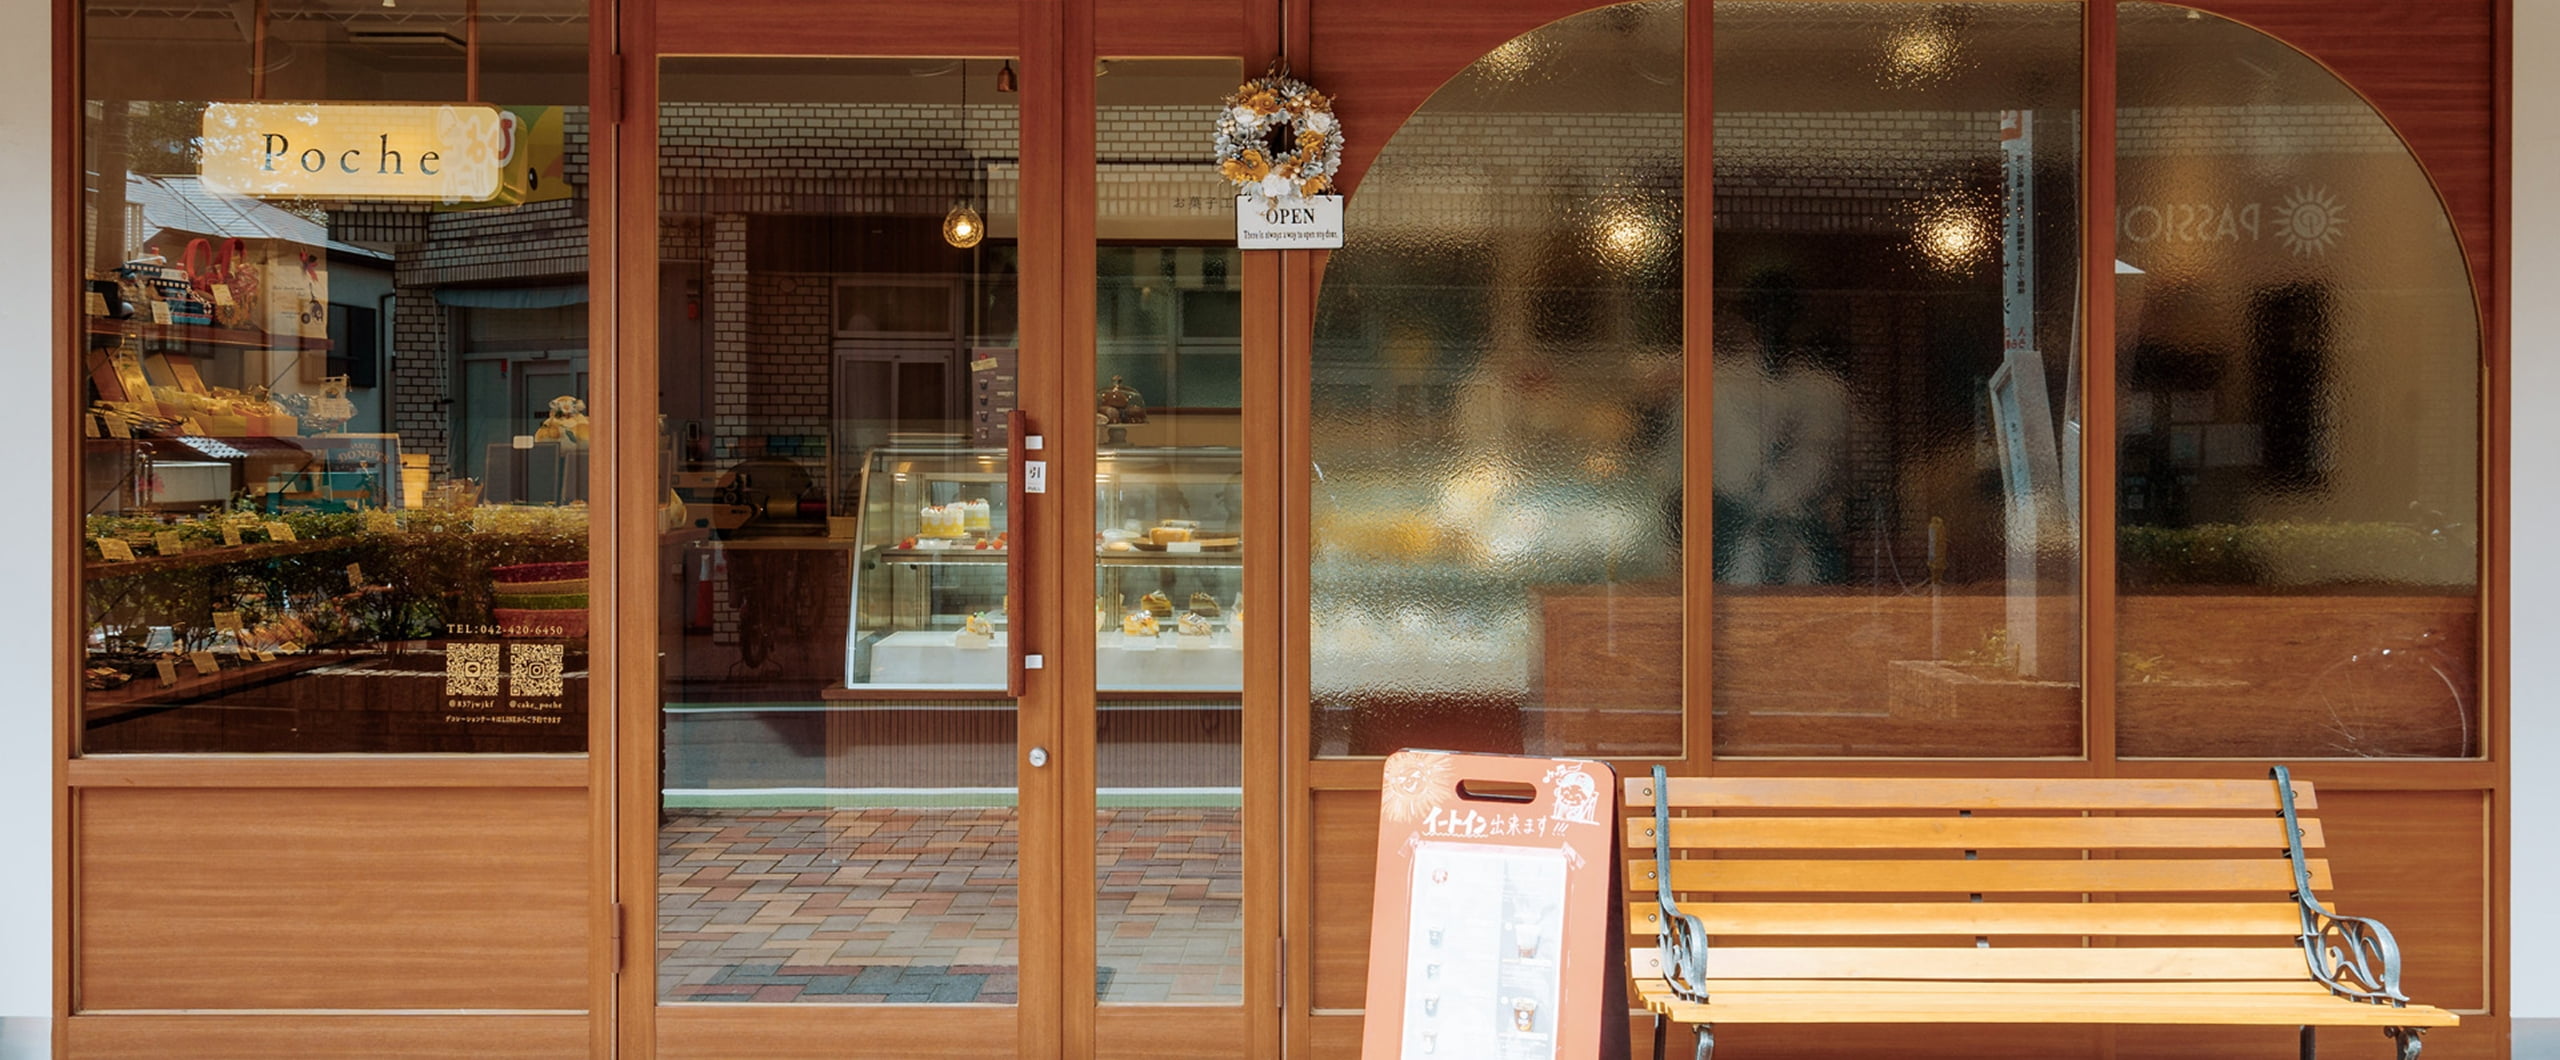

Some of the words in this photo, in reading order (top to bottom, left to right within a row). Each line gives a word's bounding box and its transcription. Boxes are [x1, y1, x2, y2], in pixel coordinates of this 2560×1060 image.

[262, 133, 440, 176] Poche
[1265, 207, 1315, 225] OPEN
[1029, 466, 1041, 479] 引
